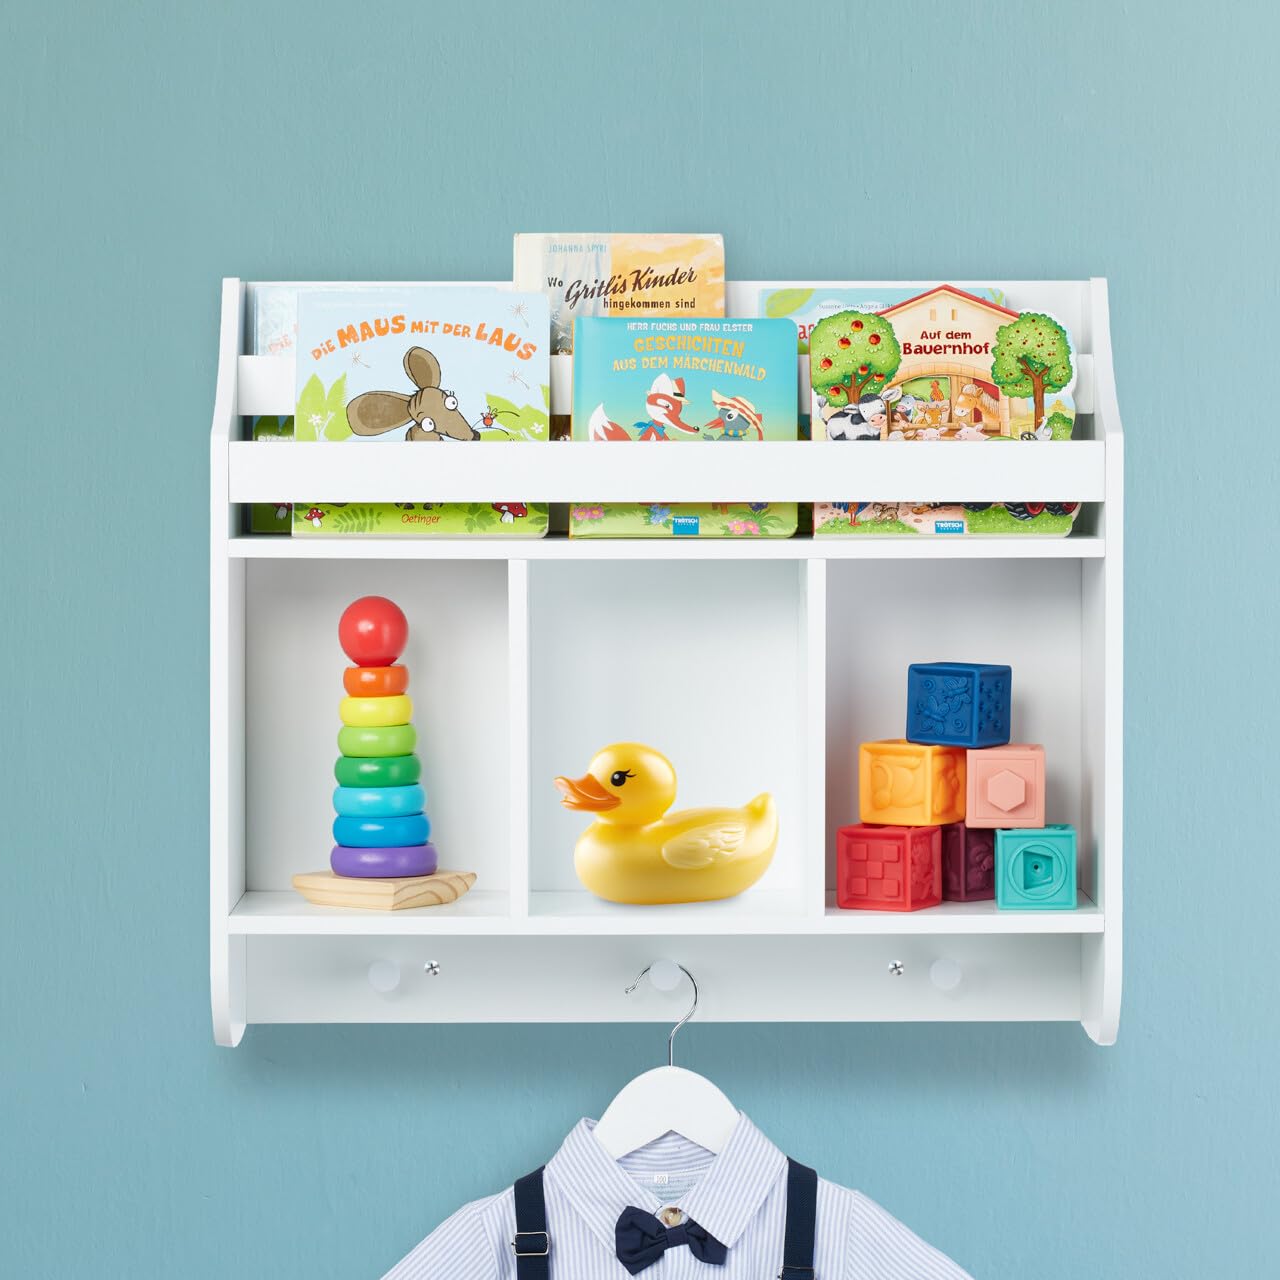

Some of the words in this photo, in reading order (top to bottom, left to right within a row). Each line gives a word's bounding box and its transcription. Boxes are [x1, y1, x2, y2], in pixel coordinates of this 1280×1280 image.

[548, 243, 583, 254] JOHANNA
[547, 277, 564, 288] Wo
[564, 273, 628, 311] Gritlis
[628, 265, 698, 293] Kinder
[603, 297, 671, 311] hingekommen
[675, 297, 696, 309] sind
[626, 322, 649, 332] HERR
[650, 322, 677, 332] FUCHS
[680, 322, 697, 332] UND
[699, 323, 721, 332] FRAU
[723, 323, 753, 332] ELSTER
[336, 314, 407, 349] MAUS
[442, 323, 472, 338] DER
[474, 322, 538, 361] LAUS
[920, 330, 942, 340] Auf
[945, 330, 972, 340] dem
[633, 335, 746, 358] GESCHICHTEN
[902, 341, 991, 356] Bauernhof
[612, 357, 637, 372] AUS
[641, 355, 669, 369] DEM
[673, 353, 767, 381] MÄRCHENWALD
[400, 513, 441, 525] Oetinger
